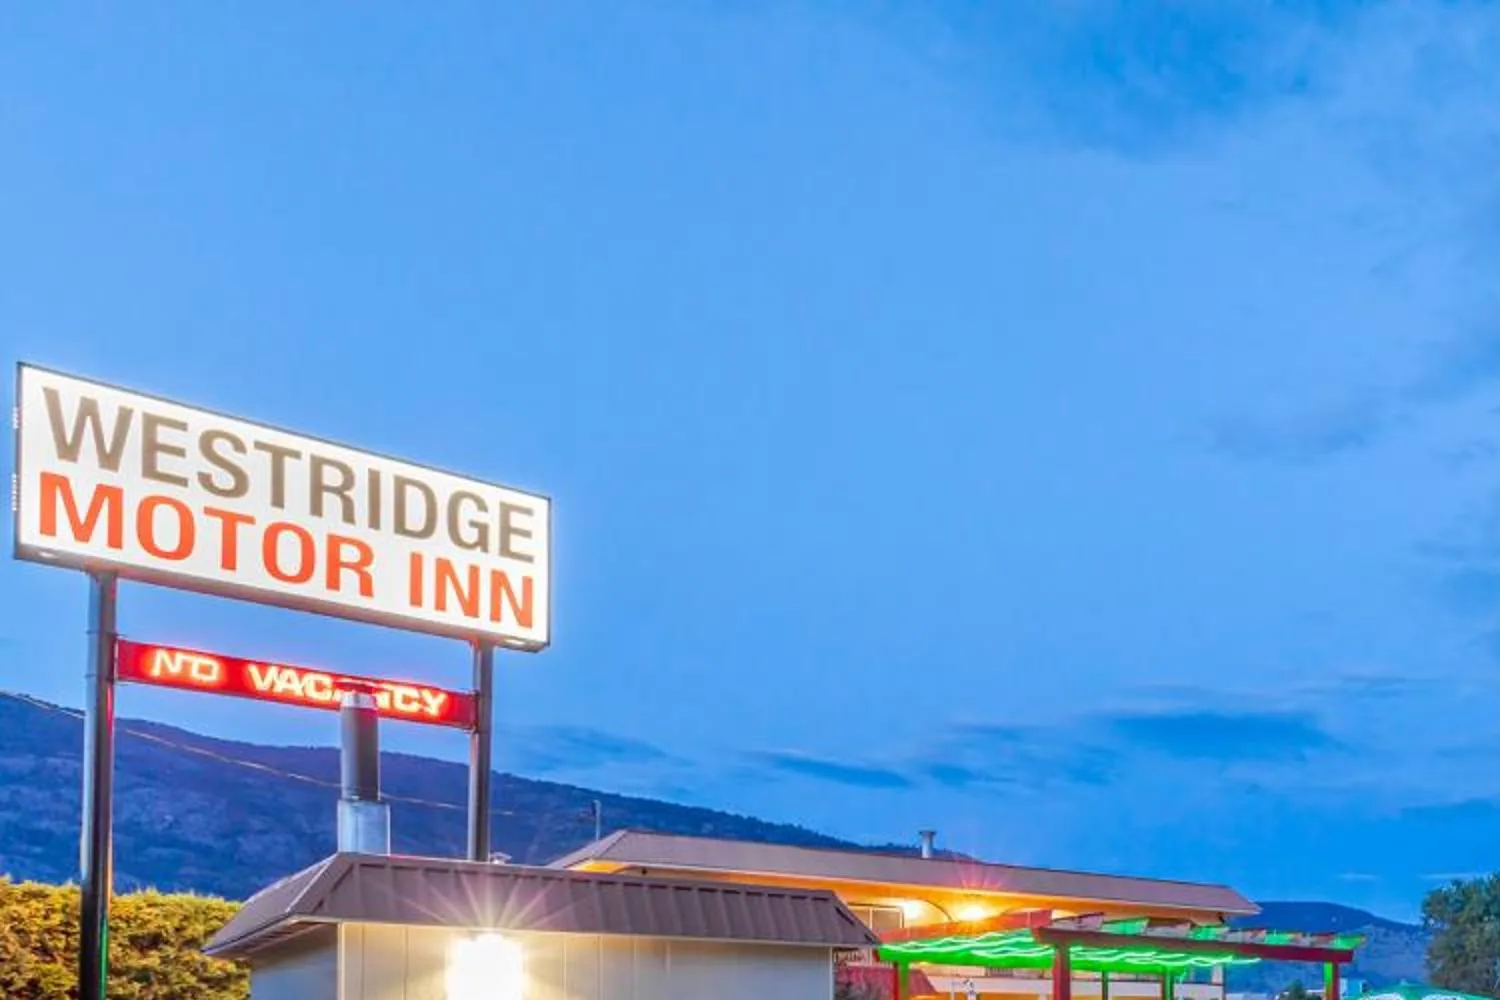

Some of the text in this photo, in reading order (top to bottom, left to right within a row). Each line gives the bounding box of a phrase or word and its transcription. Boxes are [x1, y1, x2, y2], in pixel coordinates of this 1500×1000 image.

[38, 471, 534, 629] MOTOR INN
[42, 386, 536, 563] WESTRIDGE
[153, 650, 220, 682] NO
